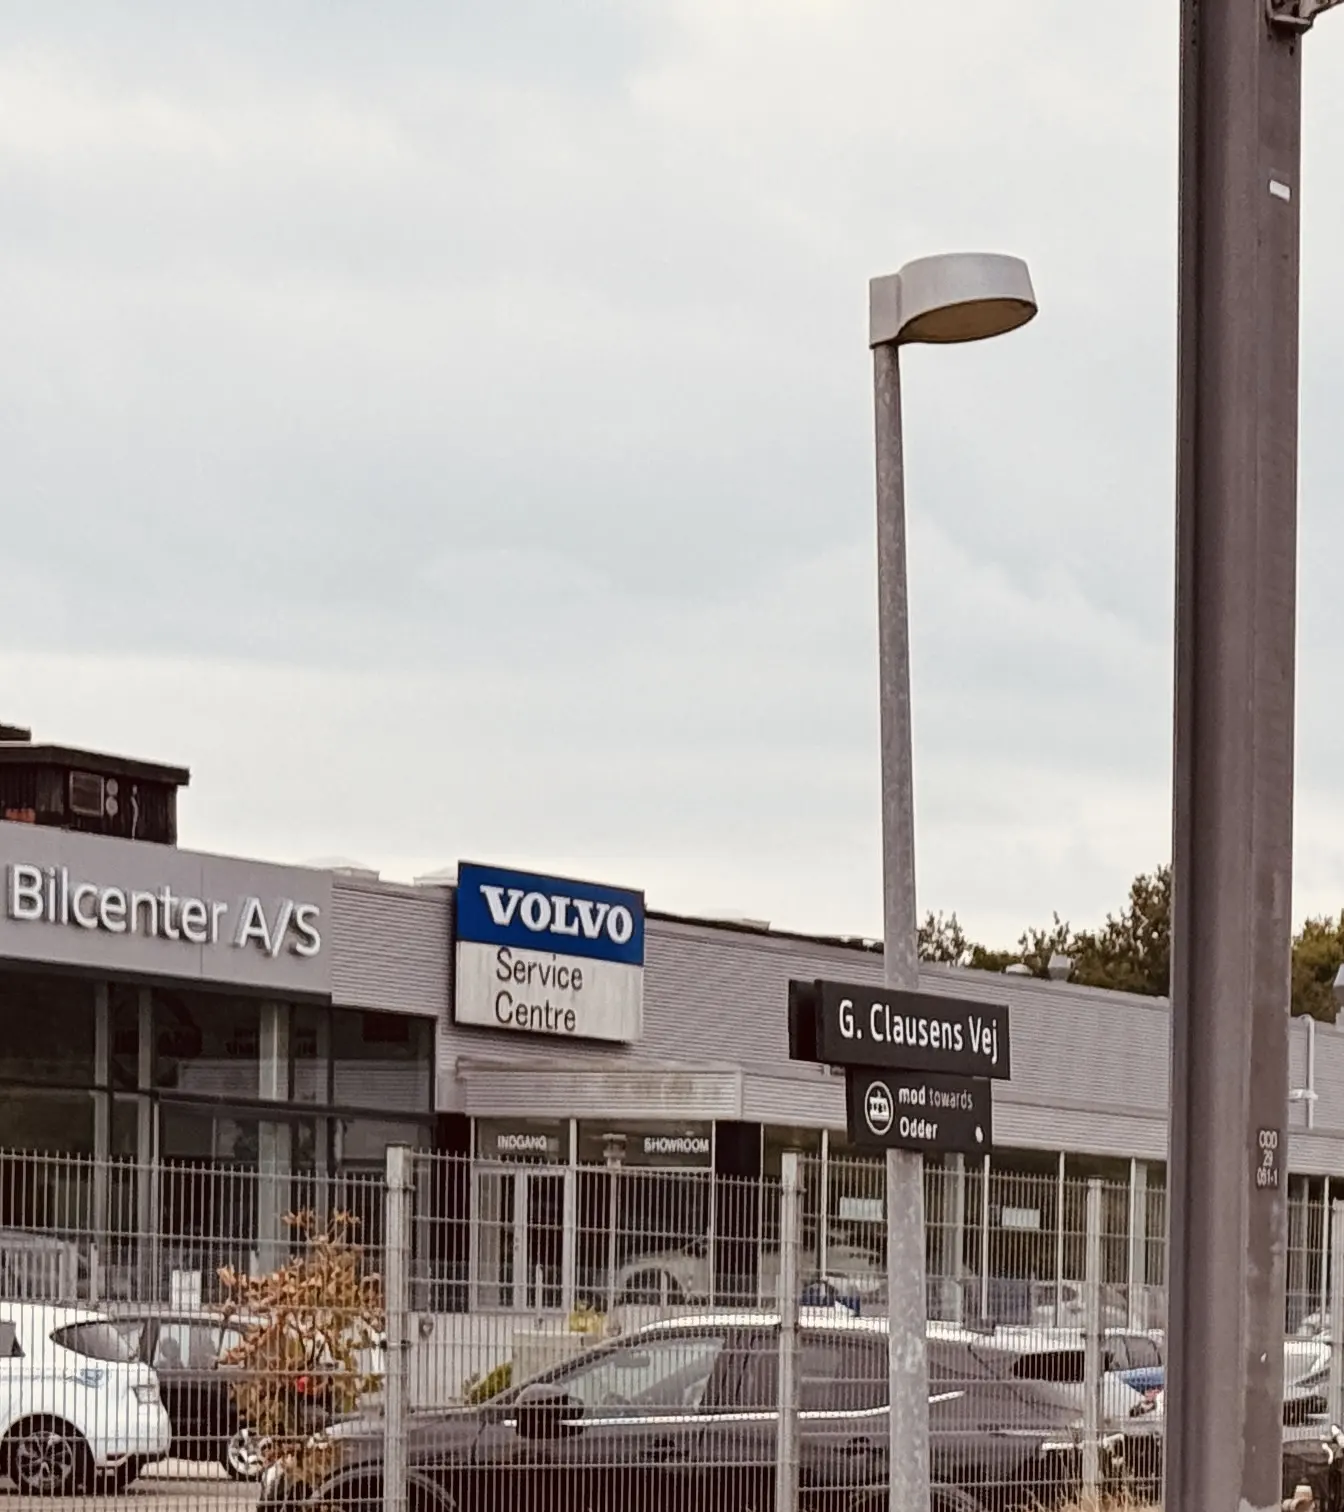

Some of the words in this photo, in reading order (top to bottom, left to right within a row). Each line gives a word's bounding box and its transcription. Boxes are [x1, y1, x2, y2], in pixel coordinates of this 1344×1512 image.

[8, 863, 228, 943] Bilcenter
[236, 897, 323, 957] A/S
[480, 885, 634, 944] VOLVO
[496, 946, 584, 991] Service
[495, 991, 577, 1032] Centre
[839, 999, 863, 1040] G.
[870, 1003, 963, 1052] Clausens
[969, 1015, 999, 1064] Vej
[898, 1085, 927, 1106] mod
[929, 1088, 973, 1110] towards
[643, 1137, 709, 1154] SHOWROOM
[899, 1116, 939, 1140] Odder
